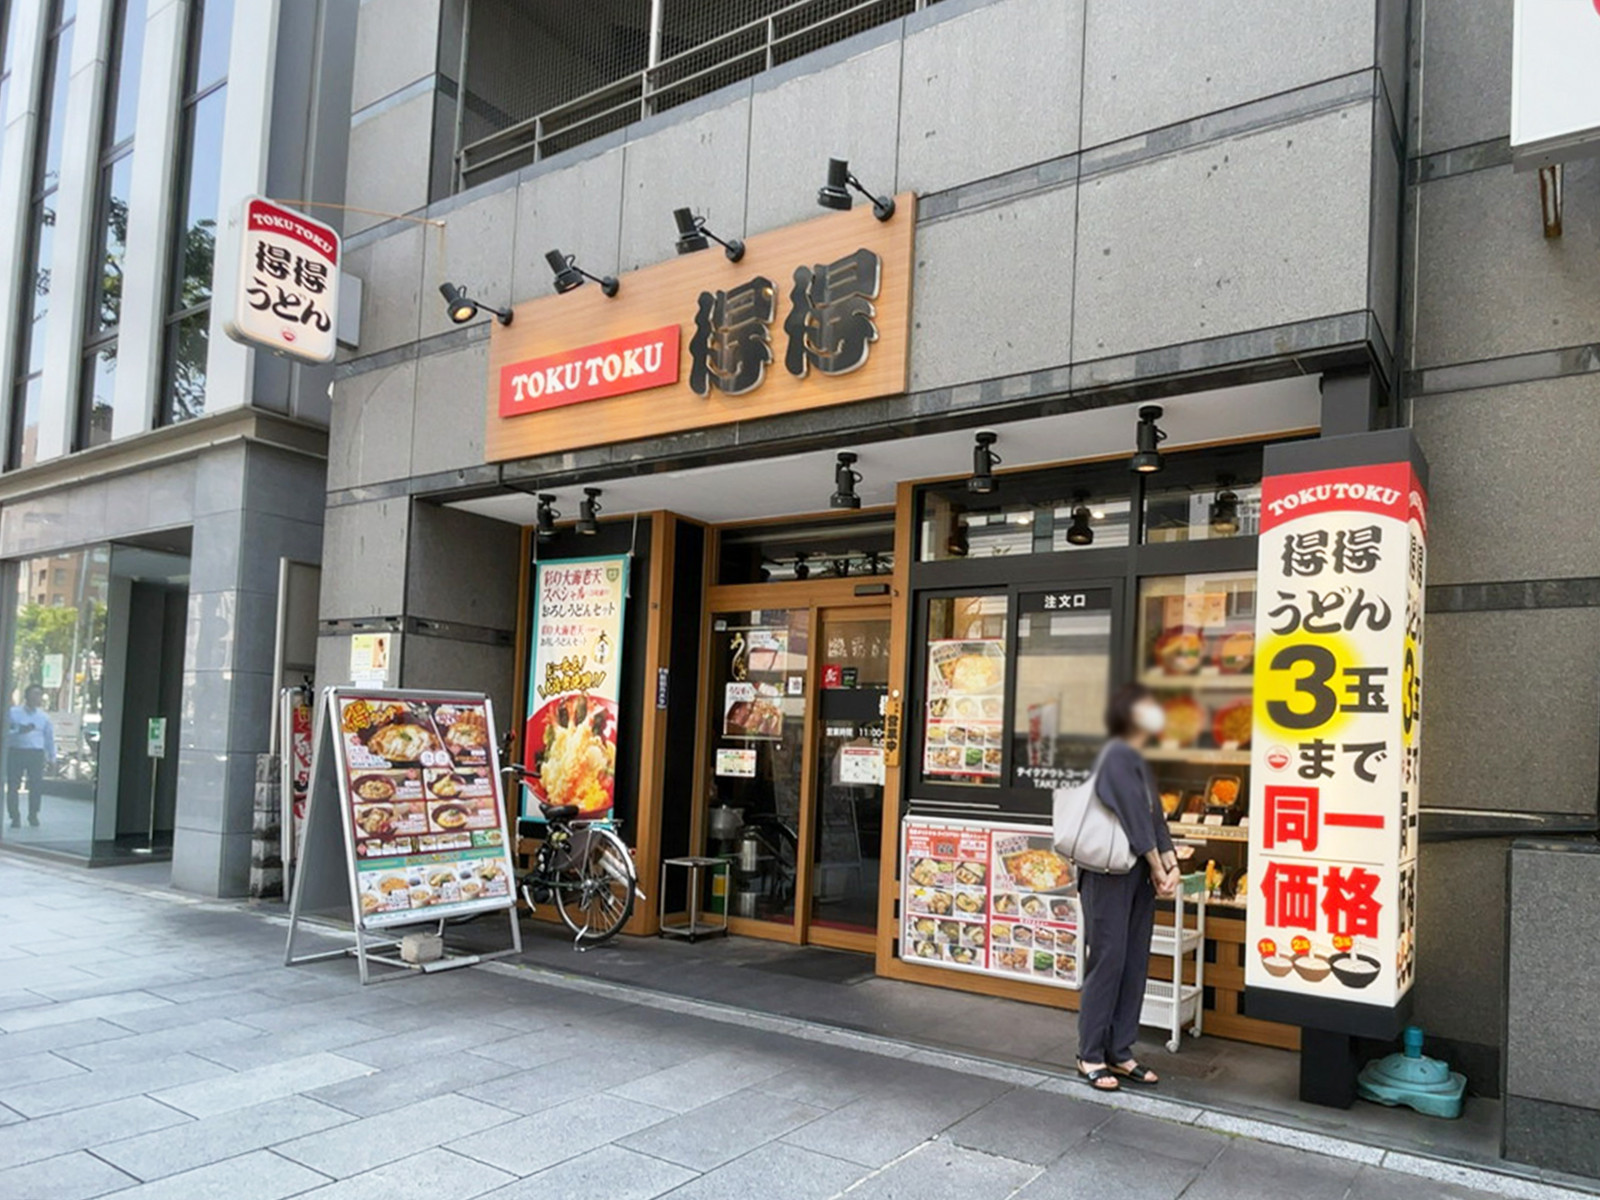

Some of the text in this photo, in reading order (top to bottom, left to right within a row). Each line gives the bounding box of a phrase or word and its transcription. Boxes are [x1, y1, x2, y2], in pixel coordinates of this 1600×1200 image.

[255, 239, 328, 295] 得得
[246, 275, 332, 334] うどん
[688, 247, 882, 399] 得得
[1280, 524, 1383, 578] 得得
[1043, 594, 1087, 609] 注文口
[1268, 585, 1392, 636] うどん
[1297, 737, 1388, 784] まで
[1263, 784, 1385, 852] 同一
[1259, 860, 1384, 939] 価格
